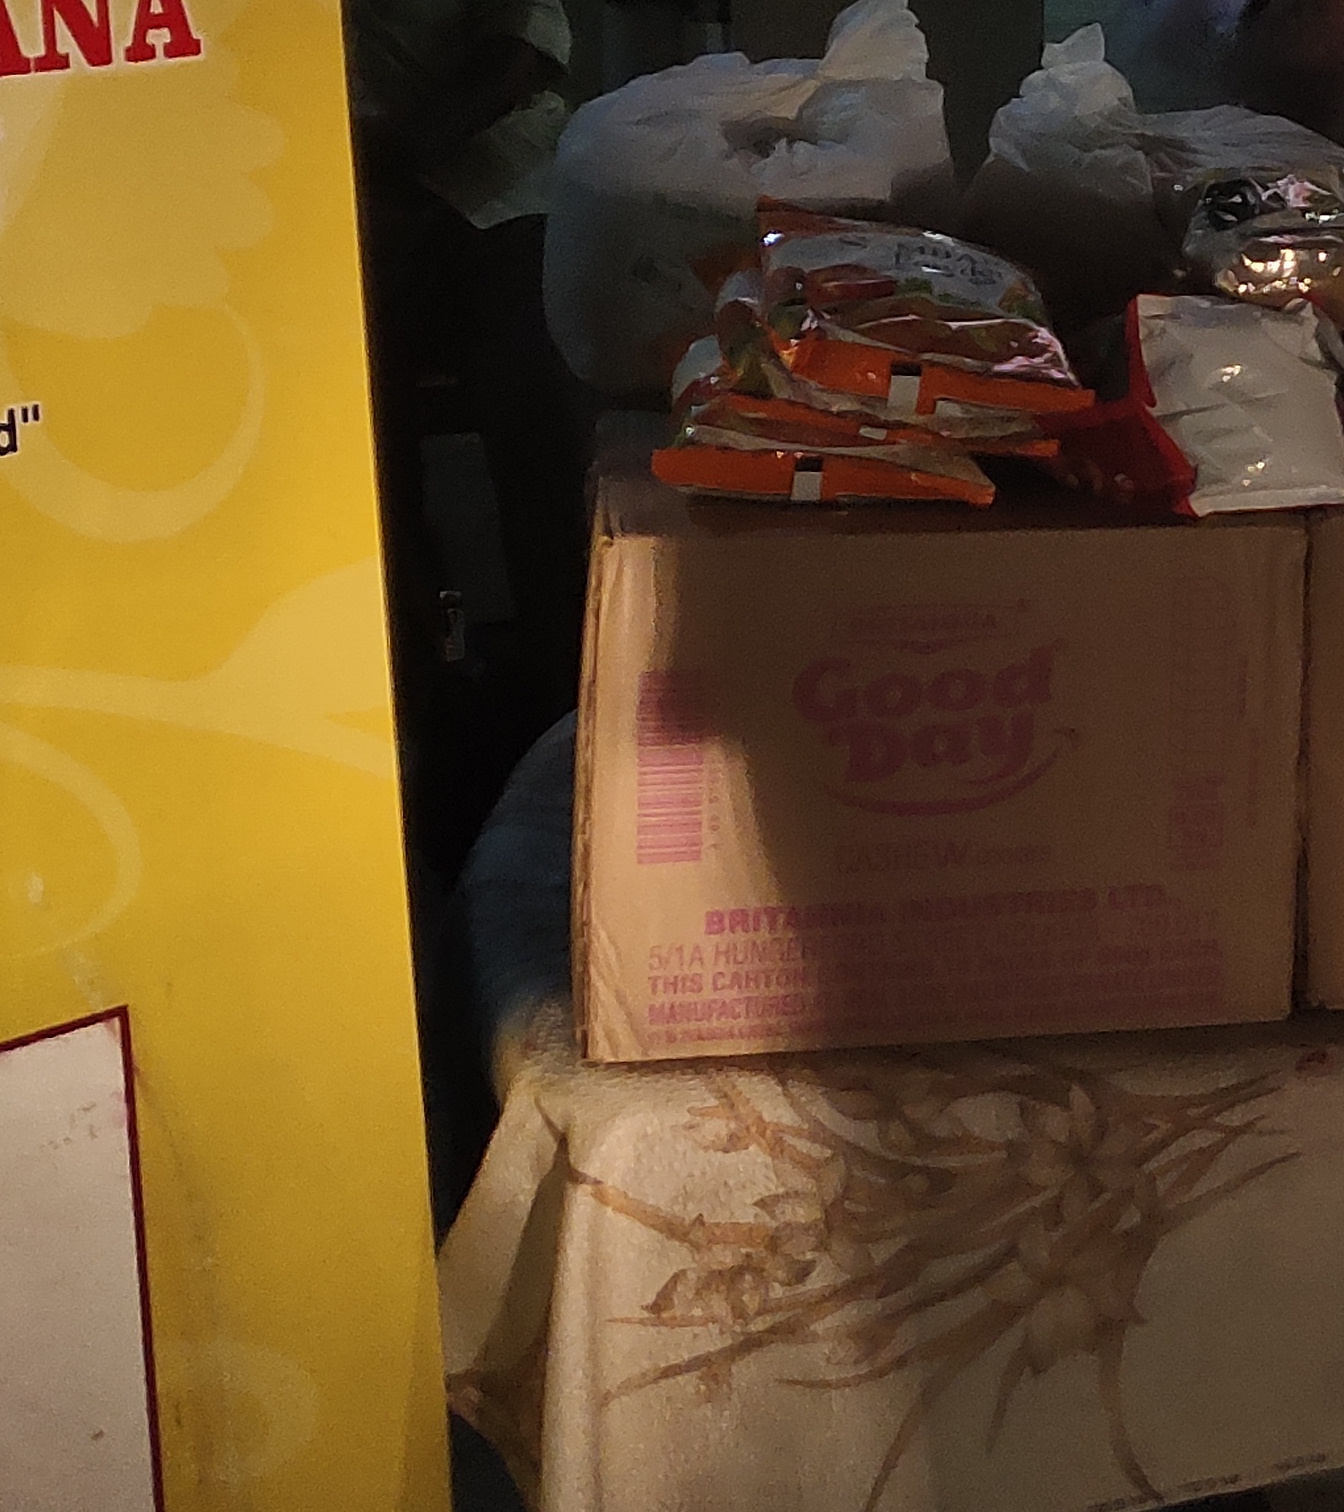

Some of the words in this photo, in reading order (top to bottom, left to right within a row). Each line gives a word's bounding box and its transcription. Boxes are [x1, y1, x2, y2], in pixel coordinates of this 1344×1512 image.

[793, 638, 1058, 724] Good
[825, 708, 1036, 786] Day
[705, 901, 886, 935] BRITANNIA
[900, 888, 1096, 921] INDUSTRIES
[648, 944, 703, 969] 5/1A
[648, 975, 702, 995] THIS
[712, 968, 807, 990] CARTON
[648, 996, 806, 1024] MANUFACTURED
